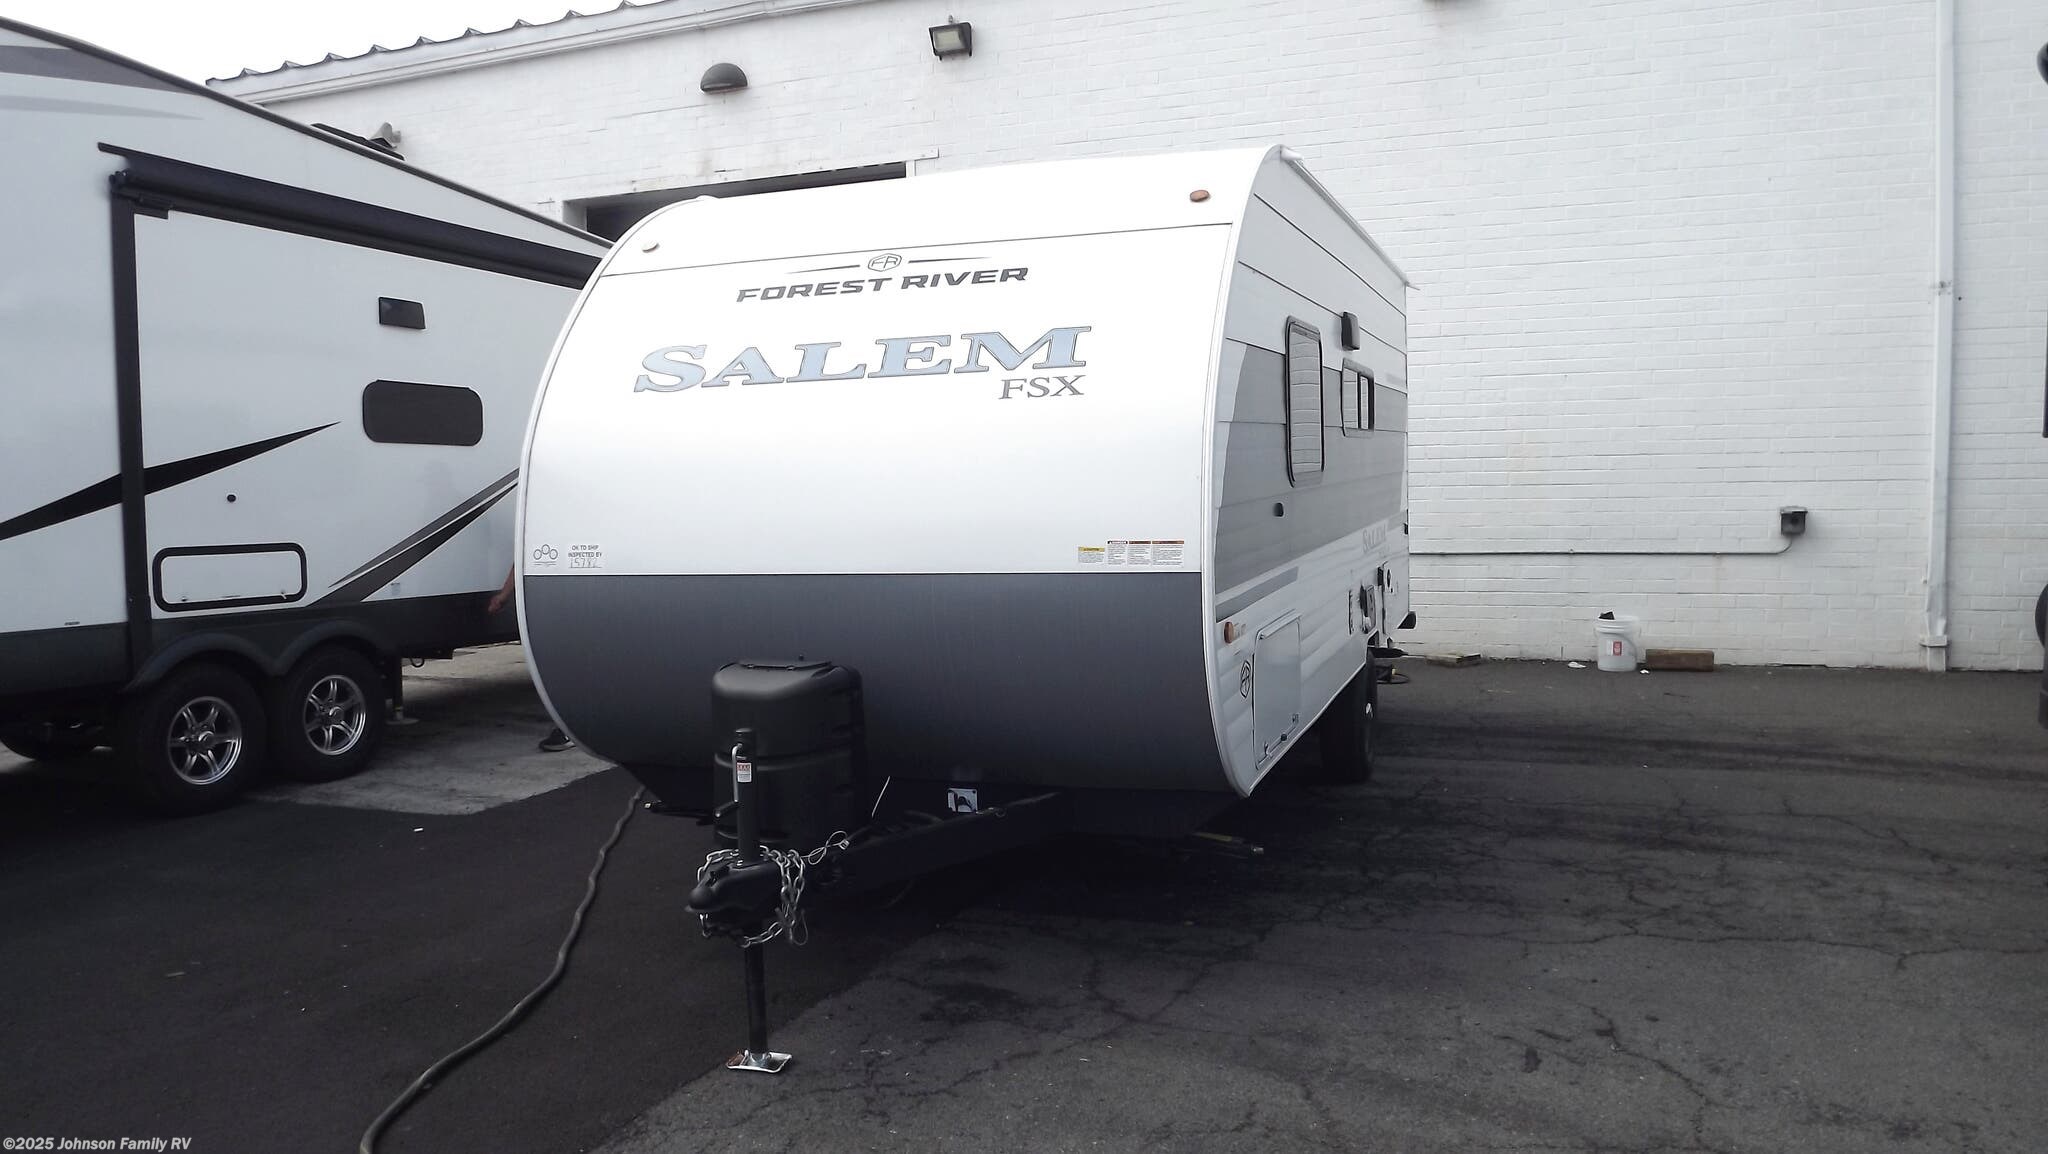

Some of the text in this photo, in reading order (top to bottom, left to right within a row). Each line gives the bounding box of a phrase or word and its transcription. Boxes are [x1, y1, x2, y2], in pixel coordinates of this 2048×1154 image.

[736, 267, 1029, 302] FOREST RIVER
[634, 326, 1091, 392] SALEM
[998, 375, 1086, 399] FSX
